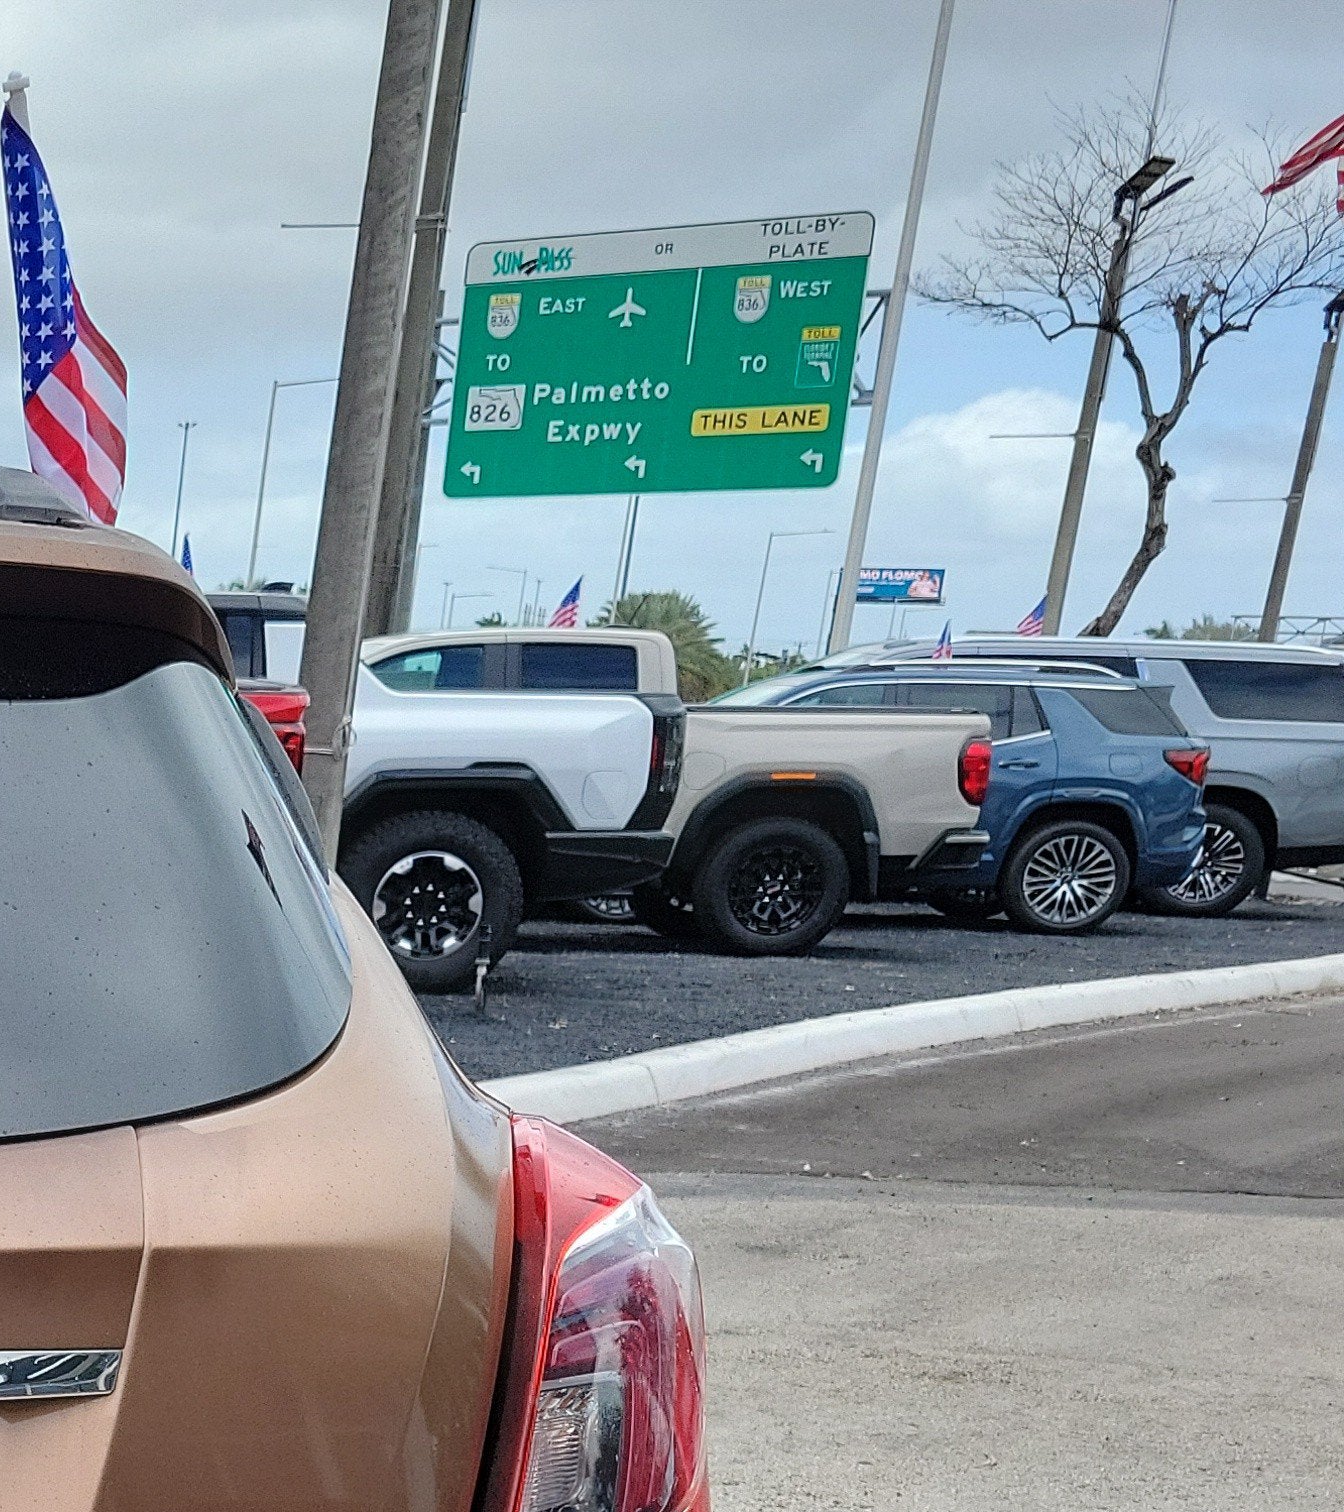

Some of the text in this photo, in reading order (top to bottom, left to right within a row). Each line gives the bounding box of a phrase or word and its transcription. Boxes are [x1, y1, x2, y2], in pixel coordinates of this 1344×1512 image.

[761, 216, 846, 237] TOLL-BY-
[654, 243, 674, 255] OR
[768, 241, 829, 259] PLATE
[779, 280, 831, 298] WEST
[538, 296, 587, 315] EAST
[737, 298, 759, 312] 836
[806, 328, 836, 339] TOLL
[486, 353, 511, 371] TO
[739, 354, 768, 373] TO
[532, 376, 670, 406] Palmetto
[469, 404, 512, 423] 826
[700, 408, 822, 431] THIS LANE
[546, 419, 643, 447] Expwy
